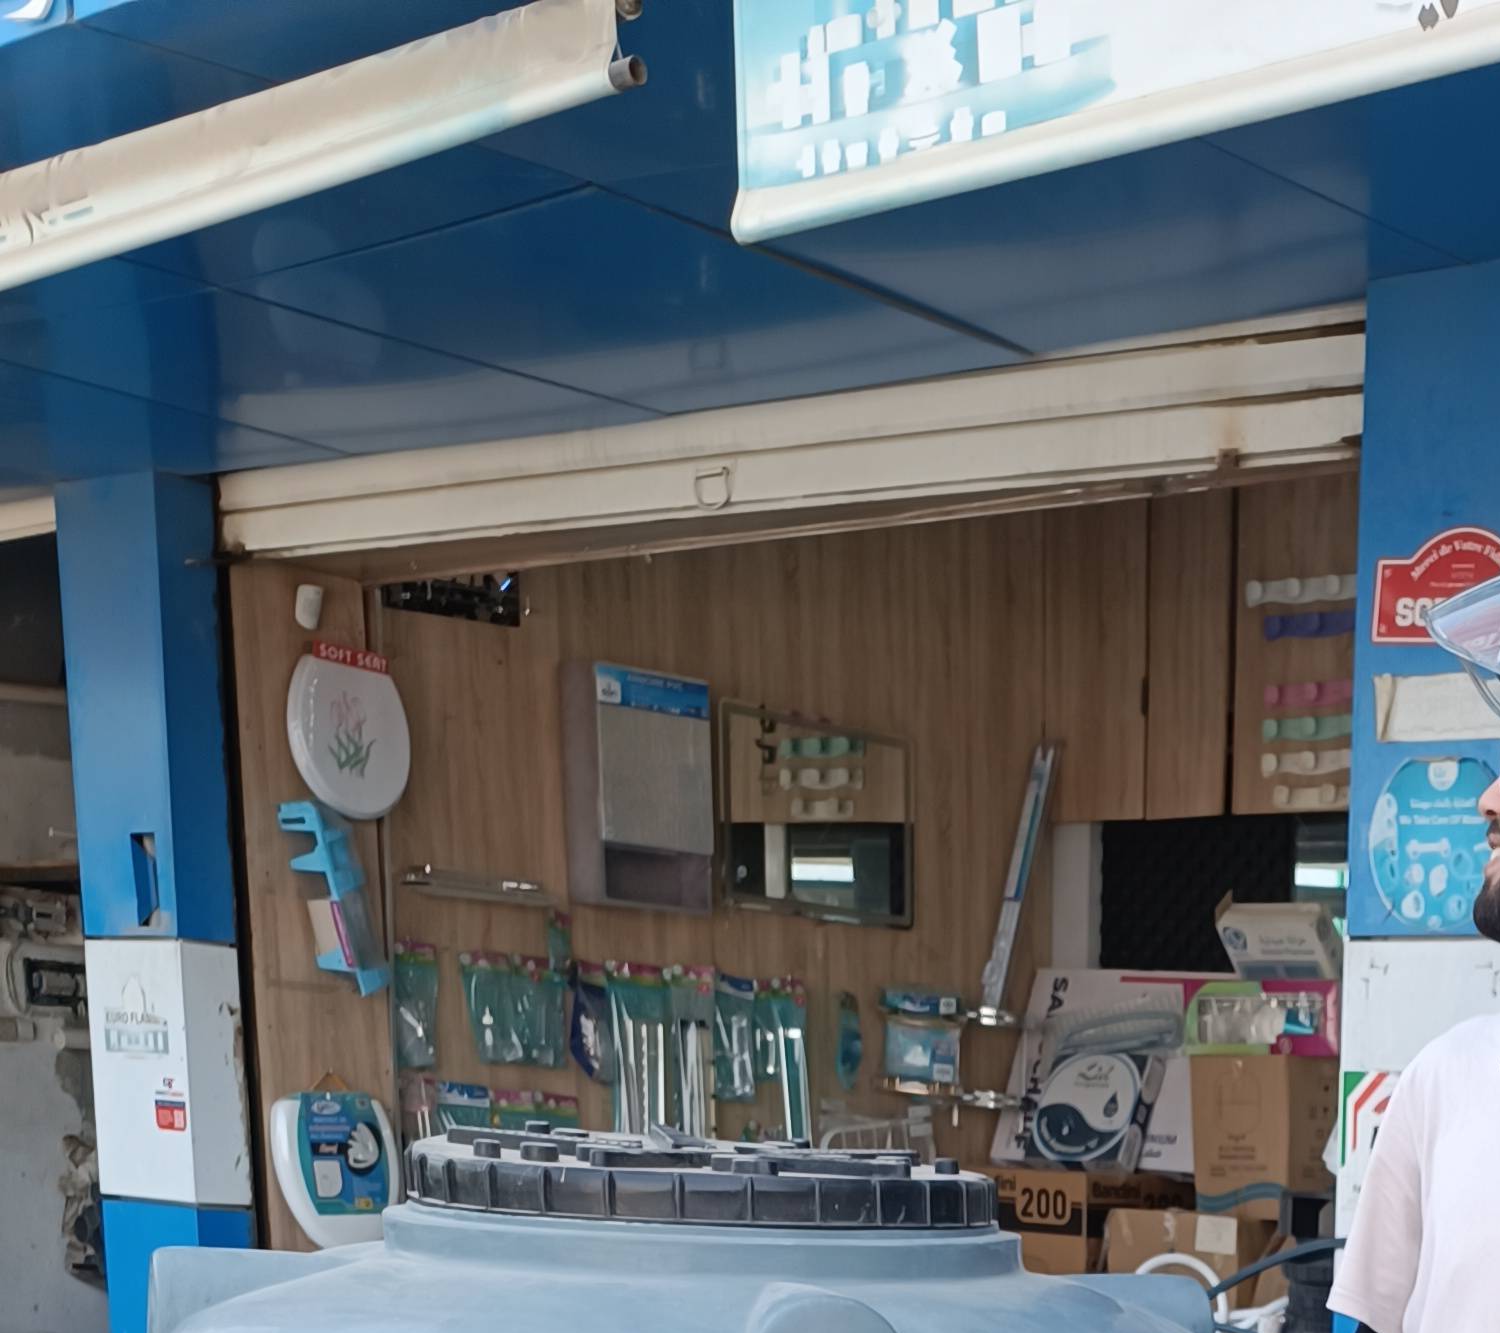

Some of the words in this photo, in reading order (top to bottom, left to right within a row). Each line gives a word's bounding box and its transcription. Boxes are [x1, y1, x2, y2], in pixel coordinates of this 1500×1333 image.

[319, 643, 352, 663] SOFT
[357, 652, 387, 672] SEAT
[1021, 1188, 1067, 1220] 200
